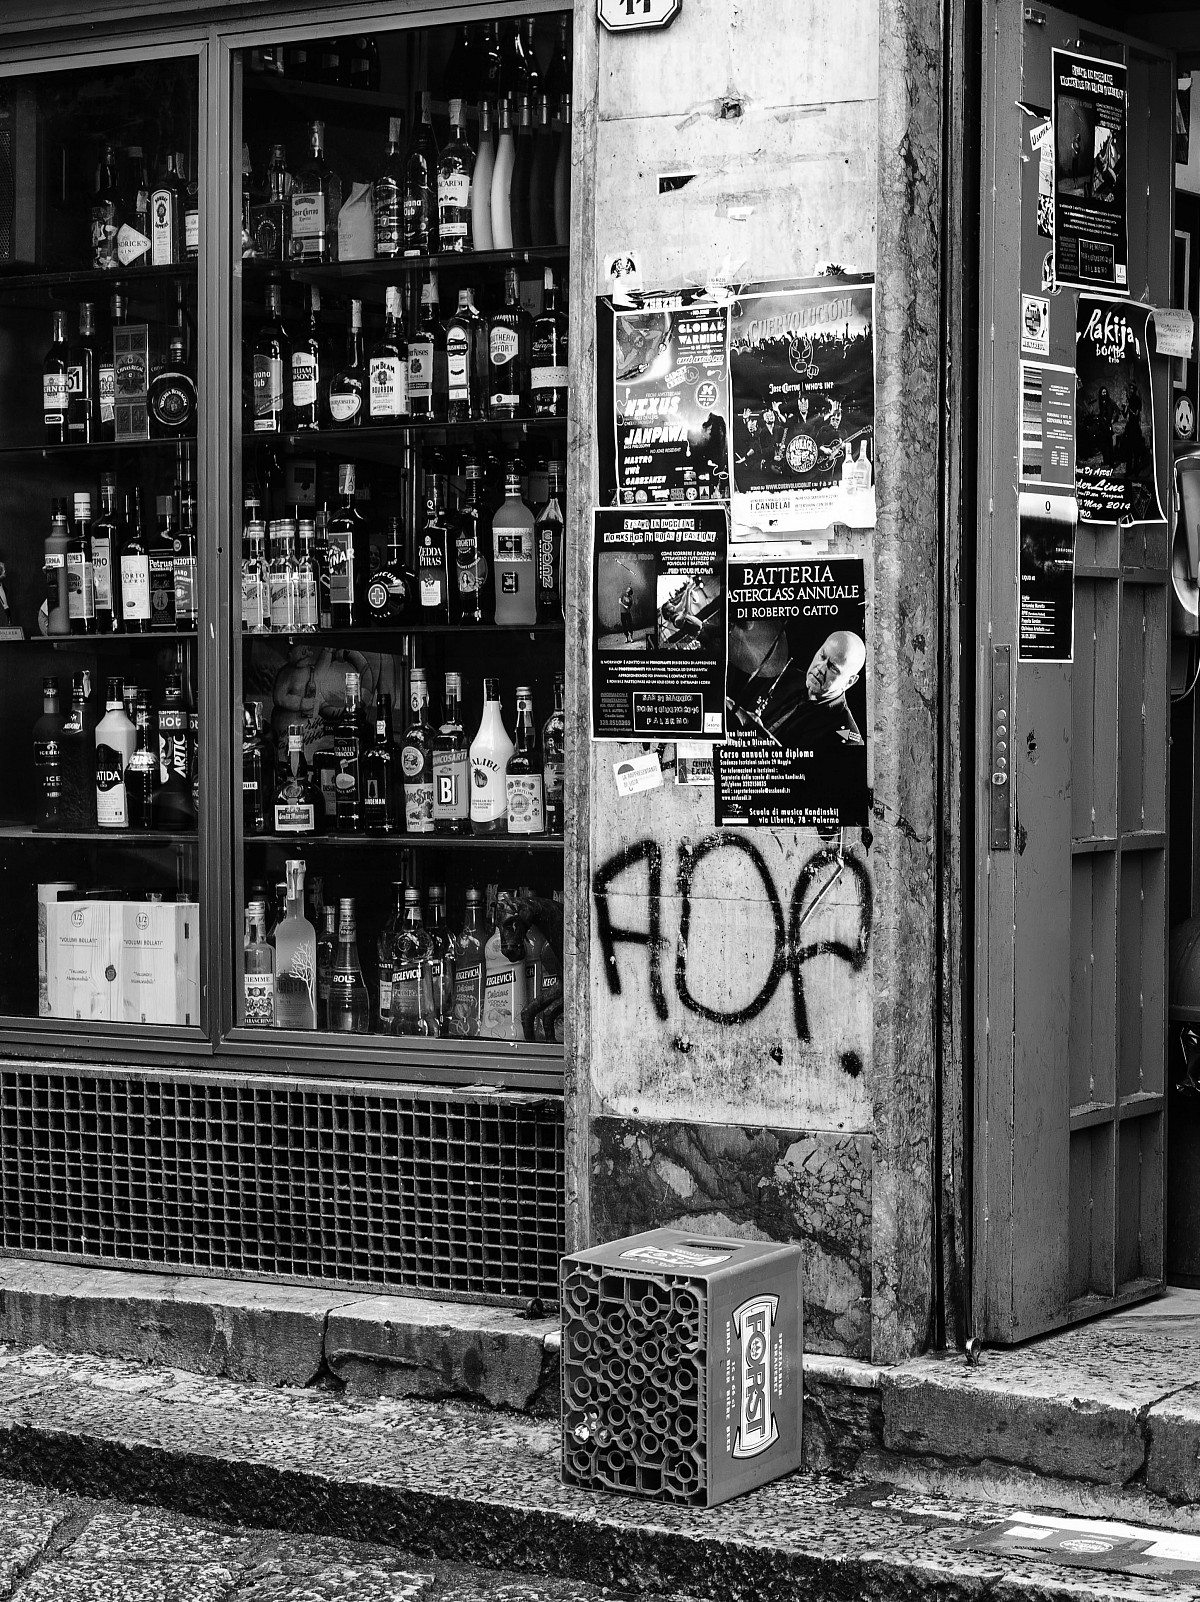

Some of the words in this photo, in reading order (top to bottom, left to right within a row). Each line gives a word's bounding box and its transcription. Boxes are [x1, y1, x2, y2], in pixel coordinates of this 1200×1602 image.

[678, 322, 725, 334] GLOBAL
[370, 364, 381, 375] JIM
[380, 361, 395, 374] BEAM
[419, 546, 443, 558] ZEDDA
[150, 559, 174, 569] Petrus
[419, 556, 442, 566] PIRAS
[743, 565, 834, 586] BATTERIA
[727, 587, 795, 603] ASTERCLASS
[796, 585, 860, 600] ANNUALE
[737, 608, 748, 618] DI
[751, 606, 800, 618] ROBERTO
[803, 605, 839, 616] GATTO
[174, 733, 187, 778] ARTIC
[786, 748, 814, 760] diploma
[471, 757, 501, 774] ALIBU
[97, 770, 121, 782] ATIDA
[749, 808, 770, 816] Scuola
[772, 808, 779, 816] di
[781, 808, 803, 816] musica
[333, 974, 356, 984] BOLS
[746, 1309, 766, 1438] FORST
